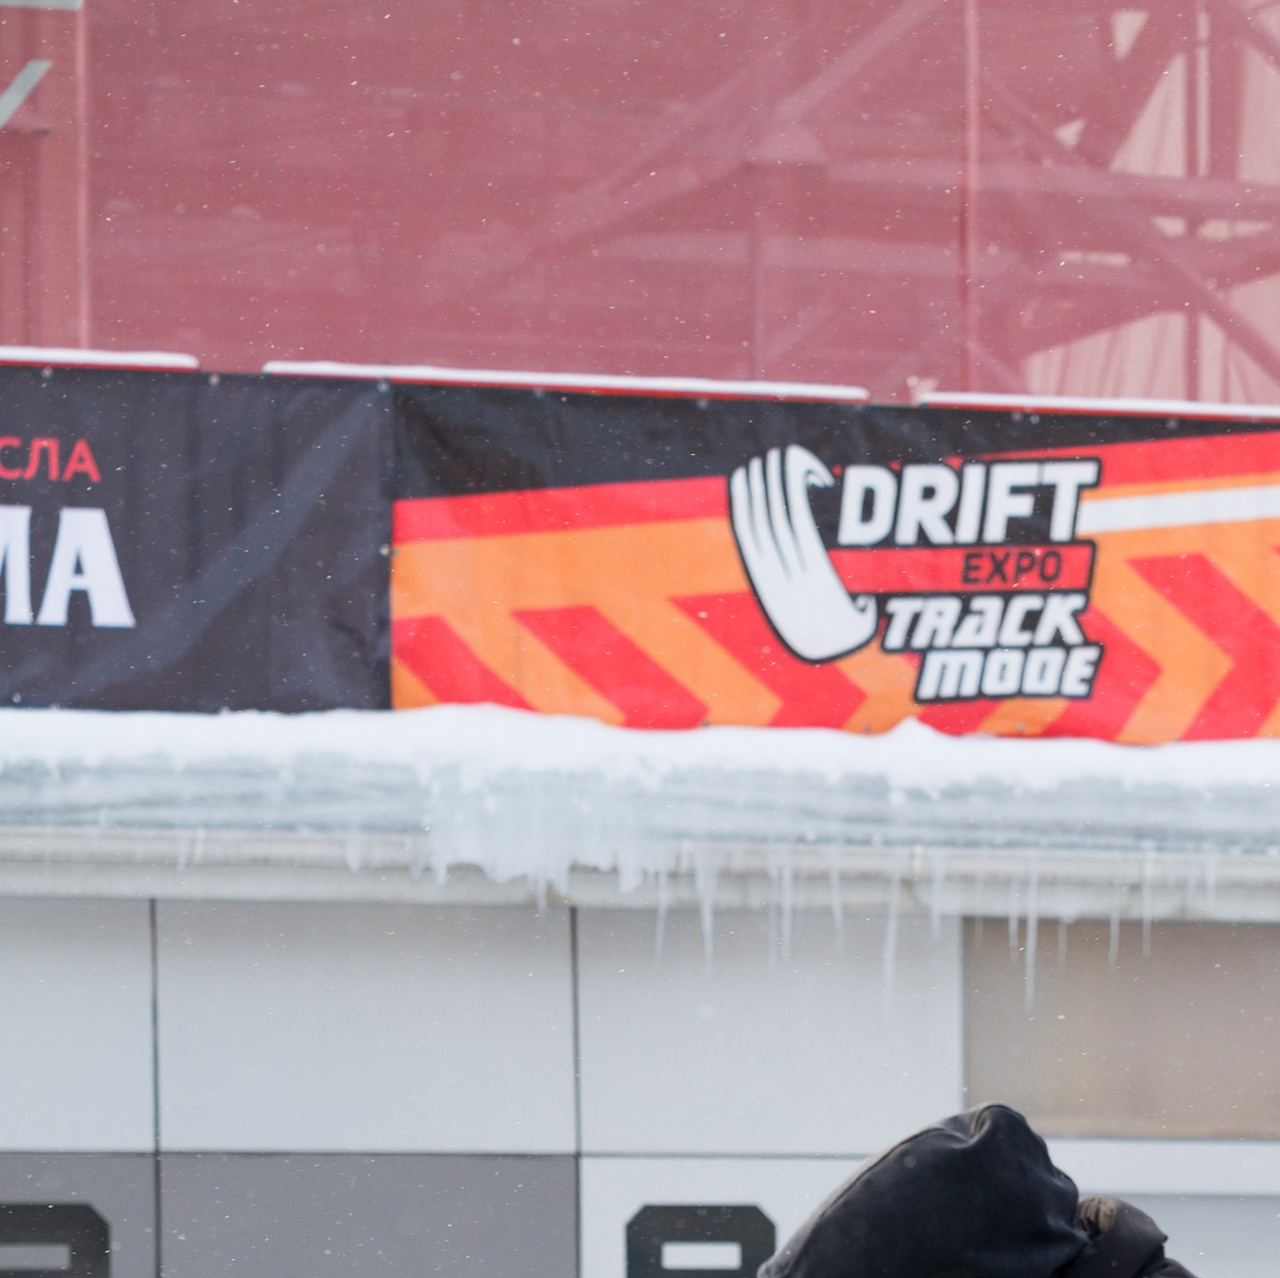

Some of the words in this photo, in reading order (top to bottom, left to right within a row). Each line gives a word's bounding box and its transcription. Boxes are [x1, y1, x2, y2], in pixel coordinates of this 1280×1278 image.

[837, 462, 1100, 546] DRIFT
[961, 551, 1062, 584] EXPO
[882, 595, 1087, 650] TRACK
[917, 647, 1102, 700] MODE
